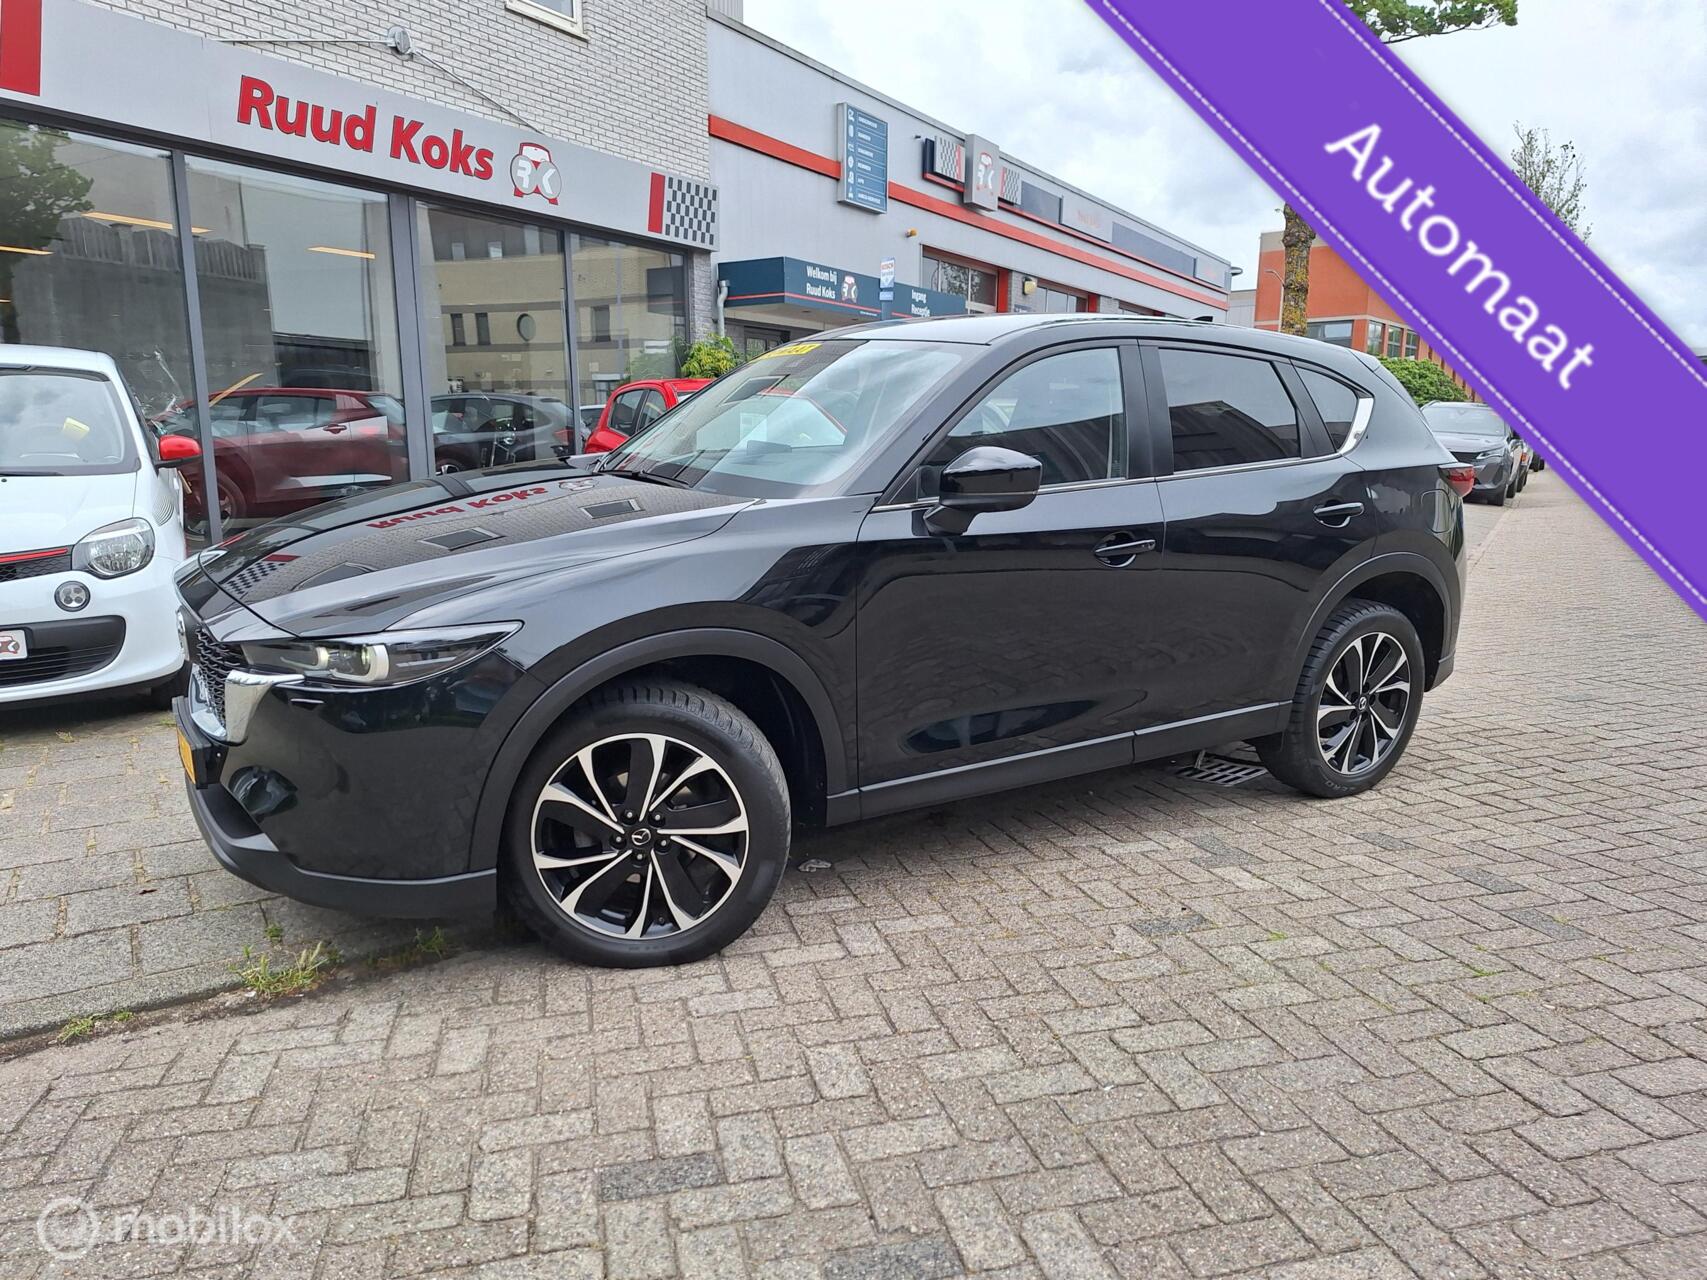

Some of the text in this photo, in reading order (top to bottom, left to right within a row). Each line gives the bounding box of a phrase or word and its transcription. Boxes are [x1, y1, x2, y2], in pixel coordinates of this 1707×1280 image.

[237, 75, 377, 153] Ruud
[390, 115, 494, 181] Koks
[806, 265, 837, 285] Welkom bij
[806, 282, 821, 298] Ruud
[822, 286, 836, 299] Koks
[911, 289, 927, 304] Ingang
